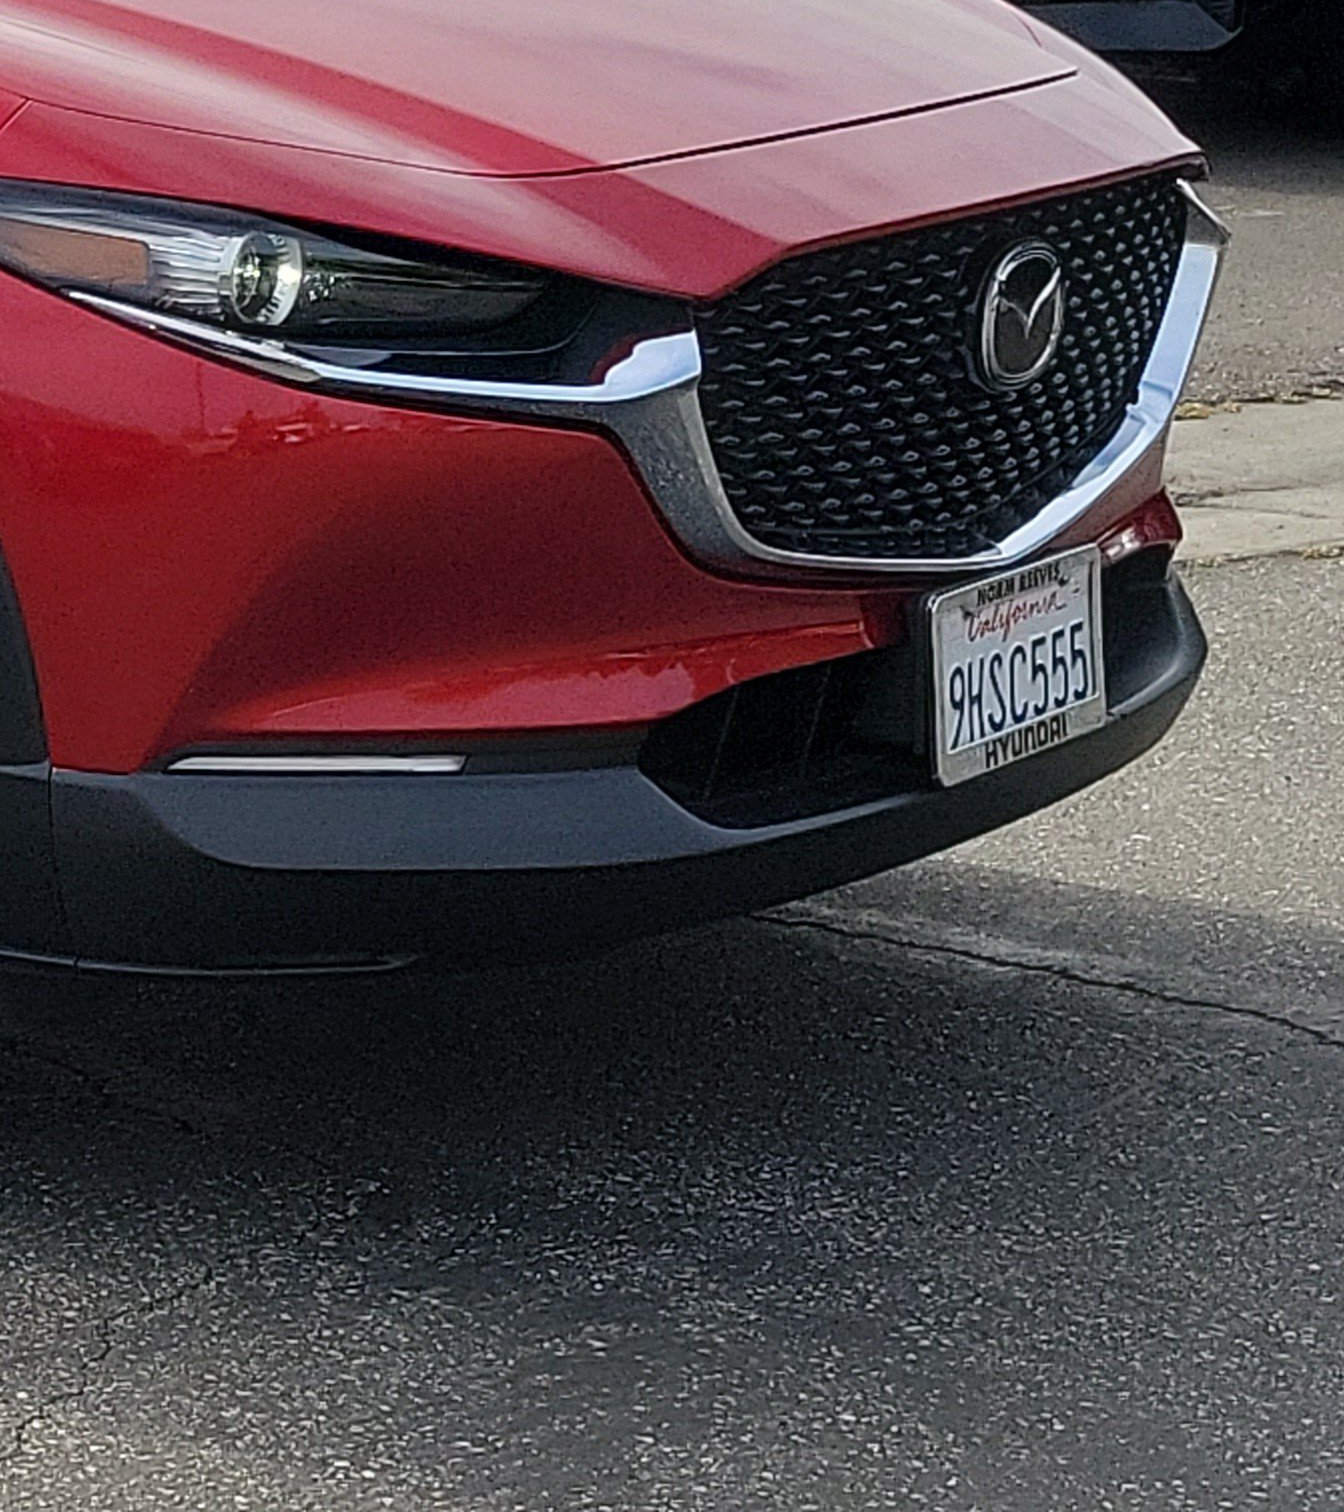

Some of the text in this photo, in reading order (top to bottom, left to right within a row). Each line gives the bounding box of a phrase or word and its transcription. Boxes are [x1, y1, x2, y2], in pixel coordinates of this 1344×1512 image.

[967, 590, 1068, 643] California
[948, 621, 1089, 751] 9HSC555
[985, 714, 1069, 769] HYUNDAI
